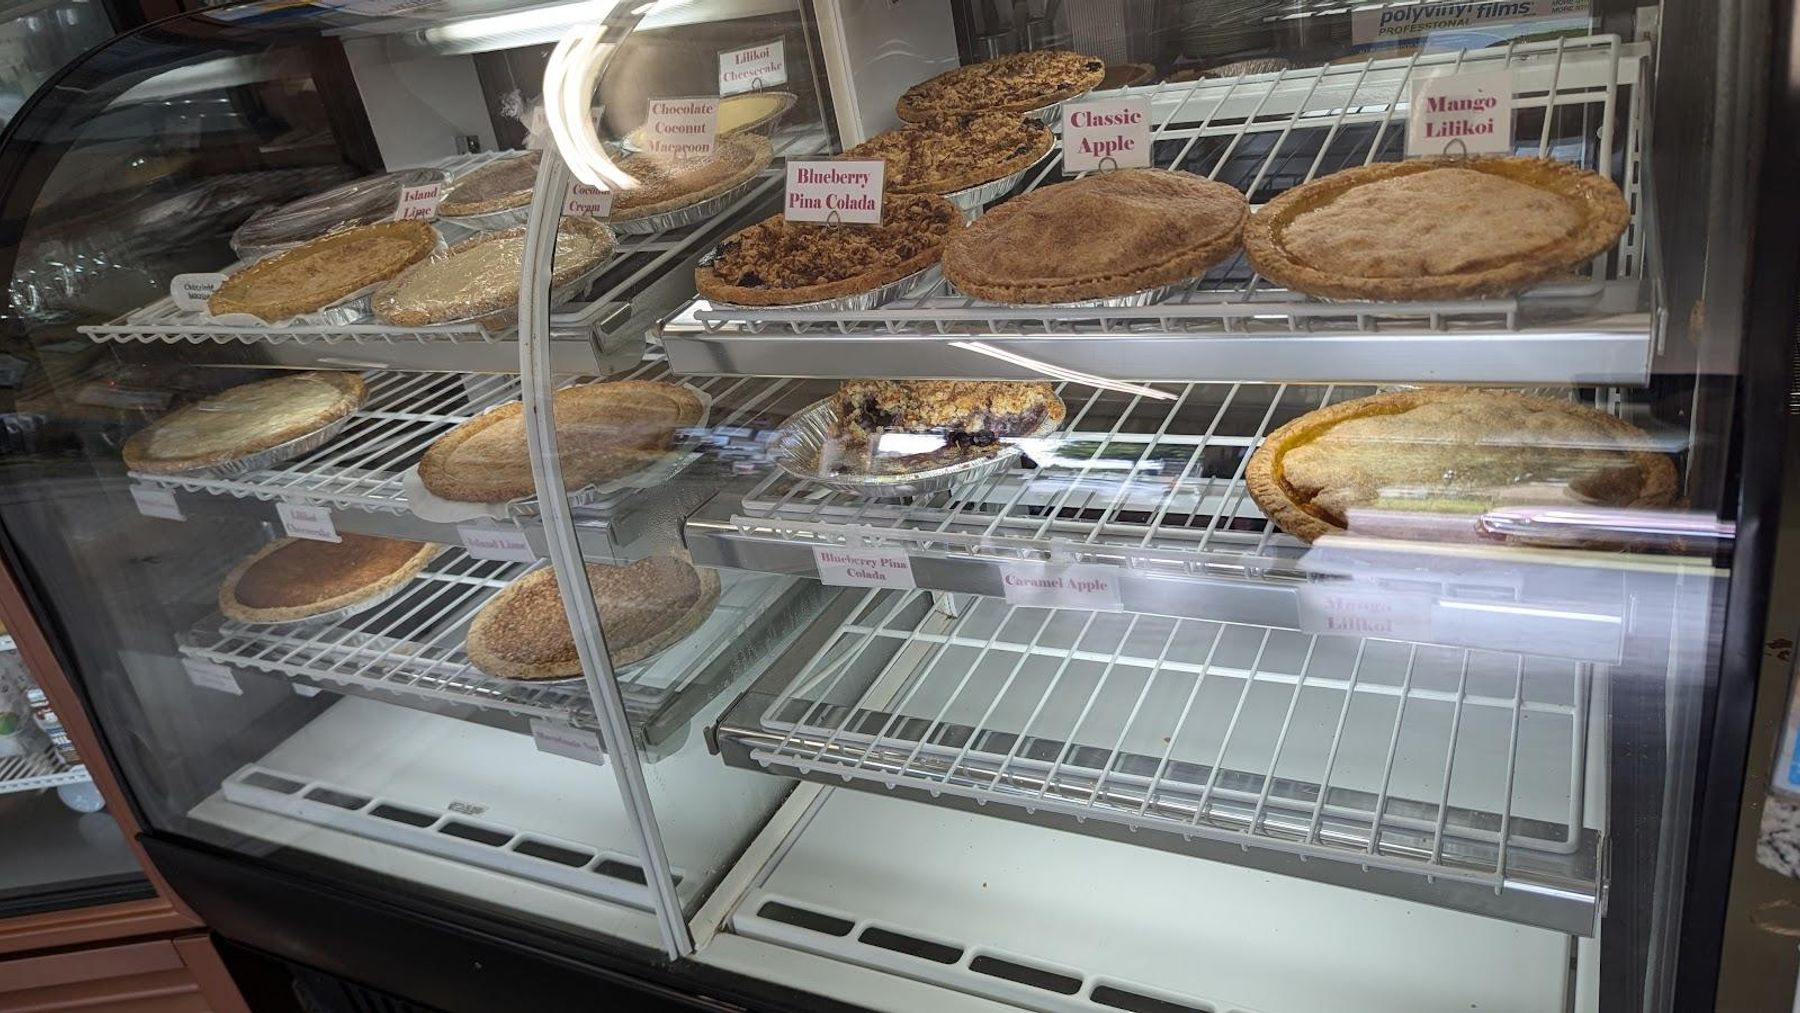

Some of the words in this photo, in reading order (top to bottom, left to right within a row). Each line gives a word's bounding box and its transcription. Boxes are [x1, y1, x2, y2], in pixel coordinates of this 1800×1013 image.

[1477, 2, 1531, 18] films
[1379, 18, 1471, 36] PROFESSIONAL
[735, 48, 770, 65] Lilikoi
[723, 63, 782, 82] Cheesecake
[652, 103, 713, 115] Chocolate
[1427, 96, 1497, 113] Mango
[1070, 108, 1142, 128] Classic
[655, 122, 706, 134] Coconut
[1426, 119, 1494, 138] Lilikoi
[648, 140, 710, 153] Macaroon
[1078, 135, 1135, 157] Apple
[797, 167, 871, 188] Blueberry
[404, 187, 438, 202] Island
[789, 193, 821, 209] Pina
[825, 193, 876, 211] Colada
[404, 207, 432, 219] Lime
[569, 201, 600, 213] Cream
[821, 552, 877, 568] Blueberry
[880, 558, 909, 569] Pina
[846, 568, 887, 581] Colada
[1005, 574, 1063, 589] Caramel
[1067, 578, 1108, 592] Apple
